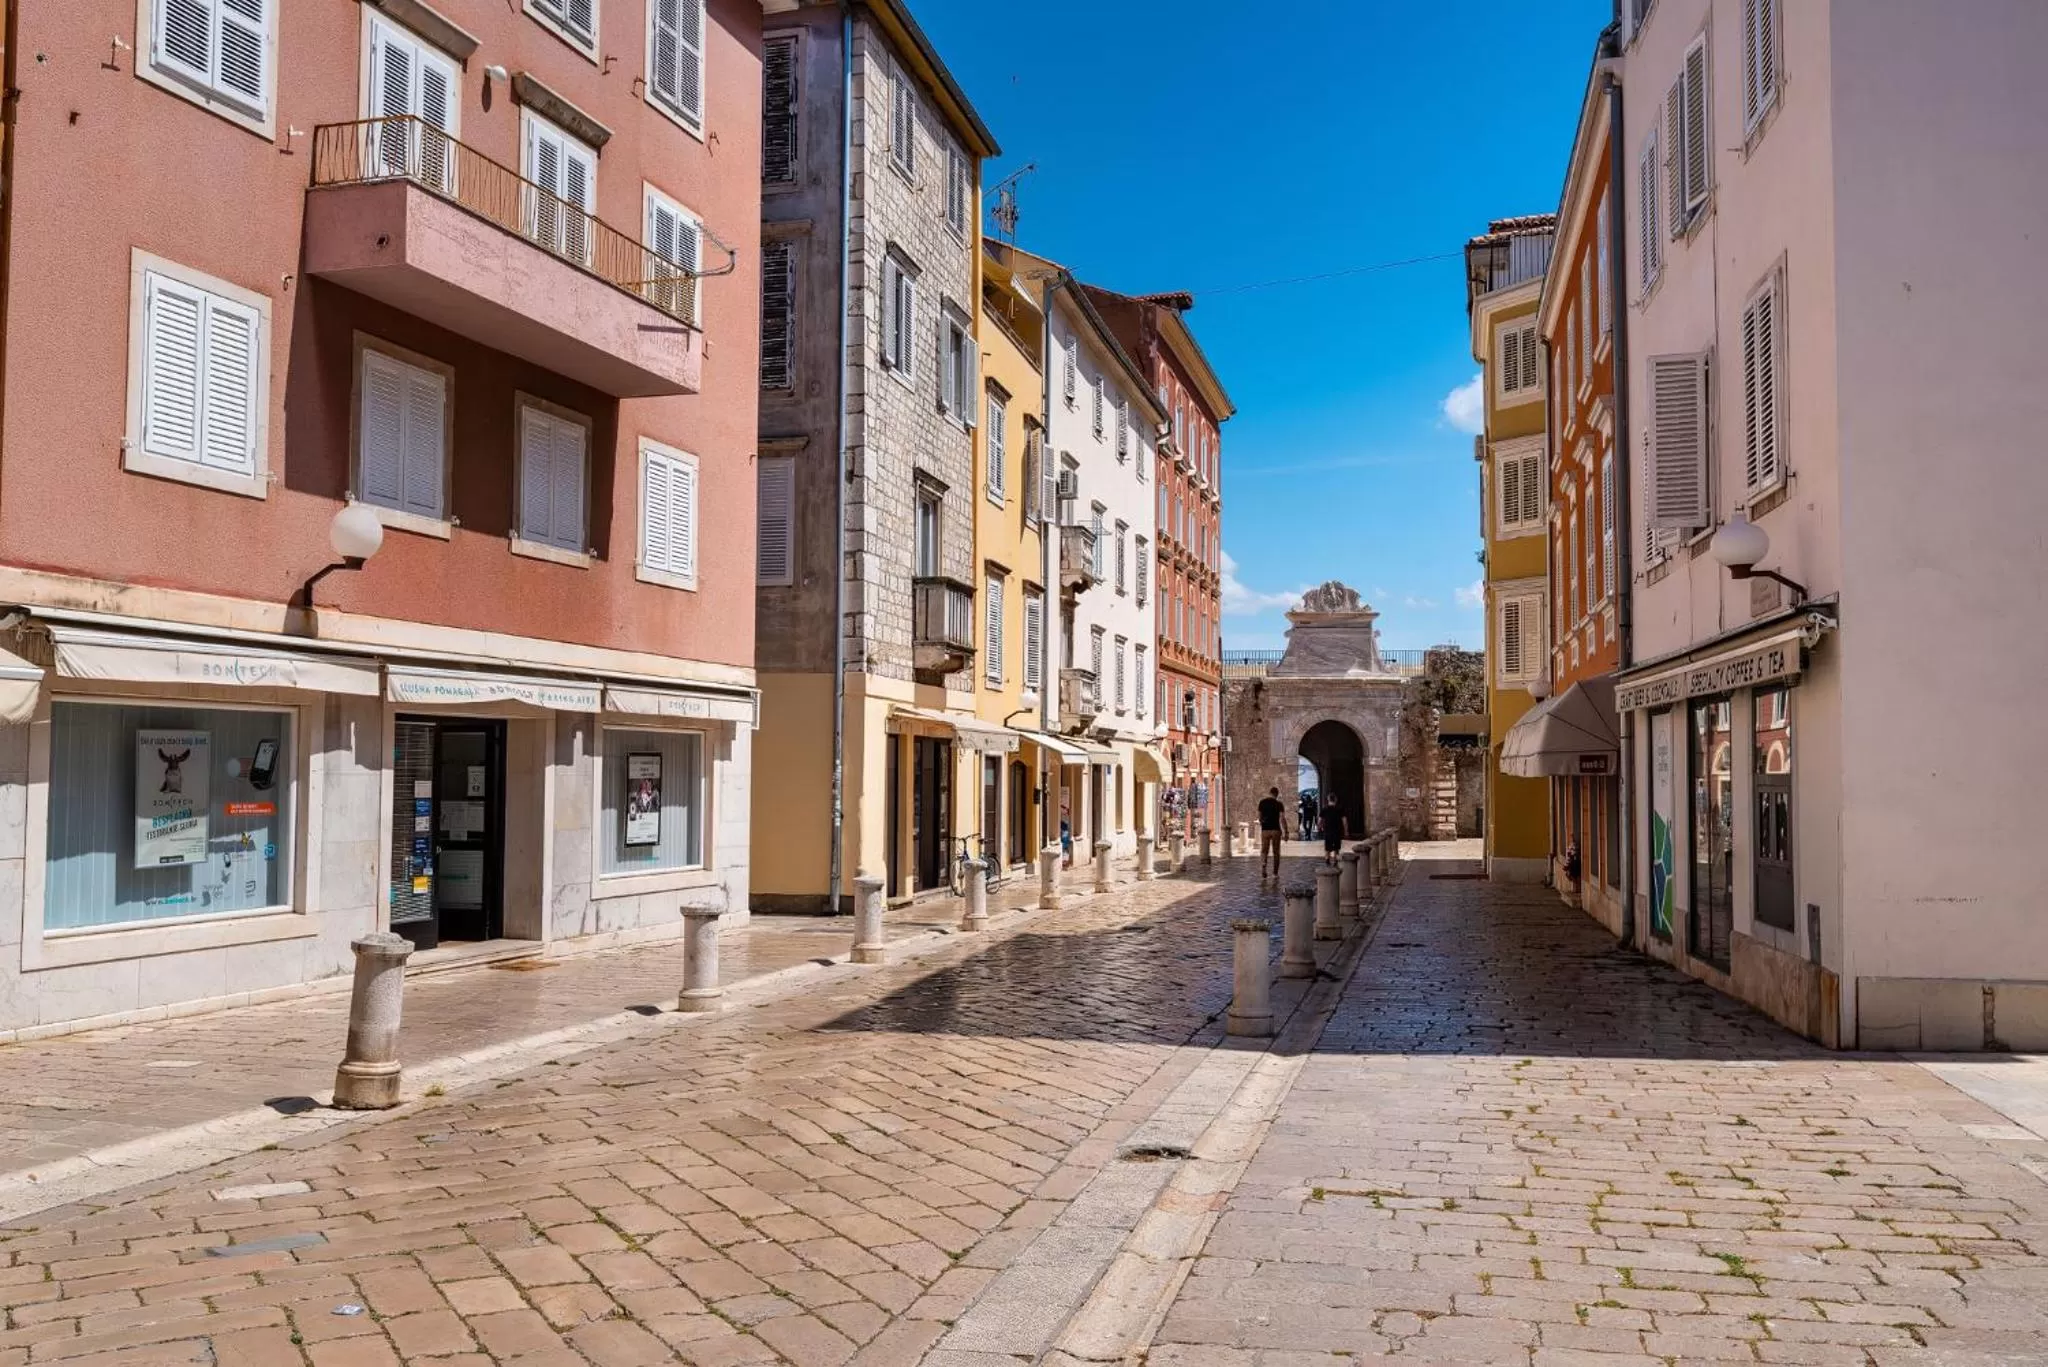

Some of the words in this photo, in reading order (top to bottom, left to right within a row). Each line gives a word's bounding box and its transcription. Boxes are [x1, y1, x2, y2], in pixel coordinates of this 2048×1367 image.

[1690, 667, 1724, 693] SPECIALTY
[1727, 658, 1754, 685] COFFEE
[1757, 656, 1763, 678] &
[1769, 650, 1785, 674] TEA
